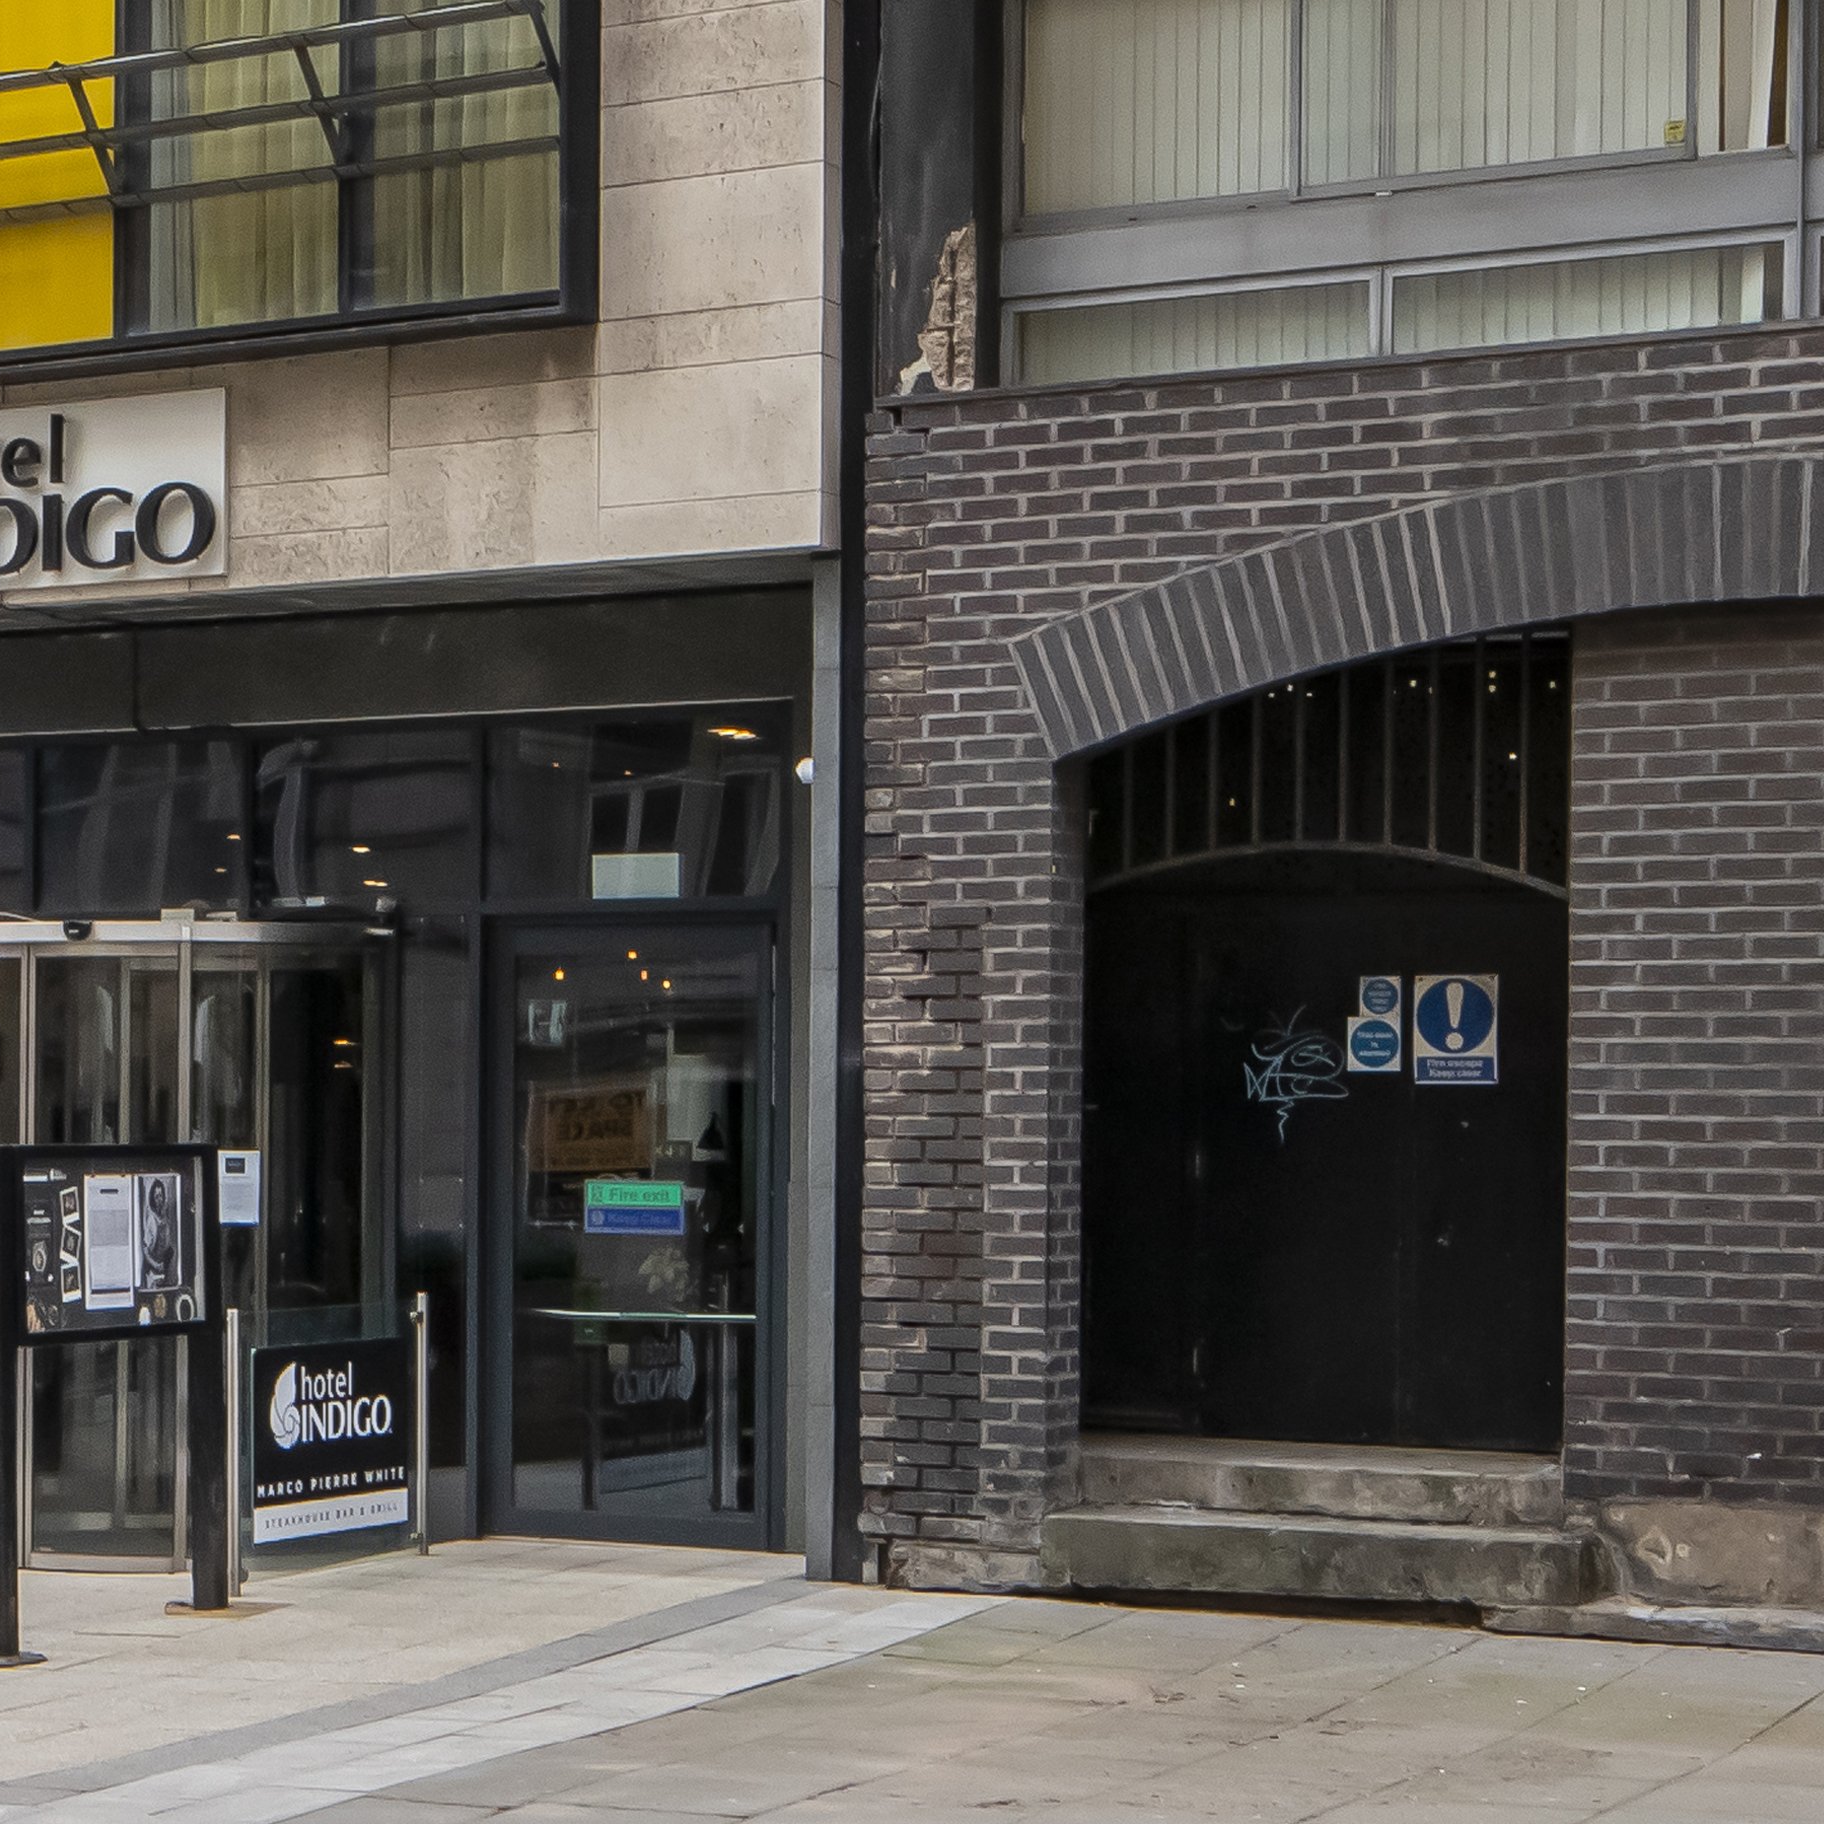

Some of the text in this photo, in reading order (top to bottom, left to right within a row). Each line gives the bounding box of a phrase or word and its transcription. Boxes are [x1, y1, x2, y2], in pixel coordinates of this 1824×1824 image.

[608, 1183, 670, 1202] Fire exit
[301, 1361, 353, 1400] hotel
[302, 1394, 392, 1443] INDIGO
[257, 1466, 405, 1498] MARCO PIERRE WHITE
